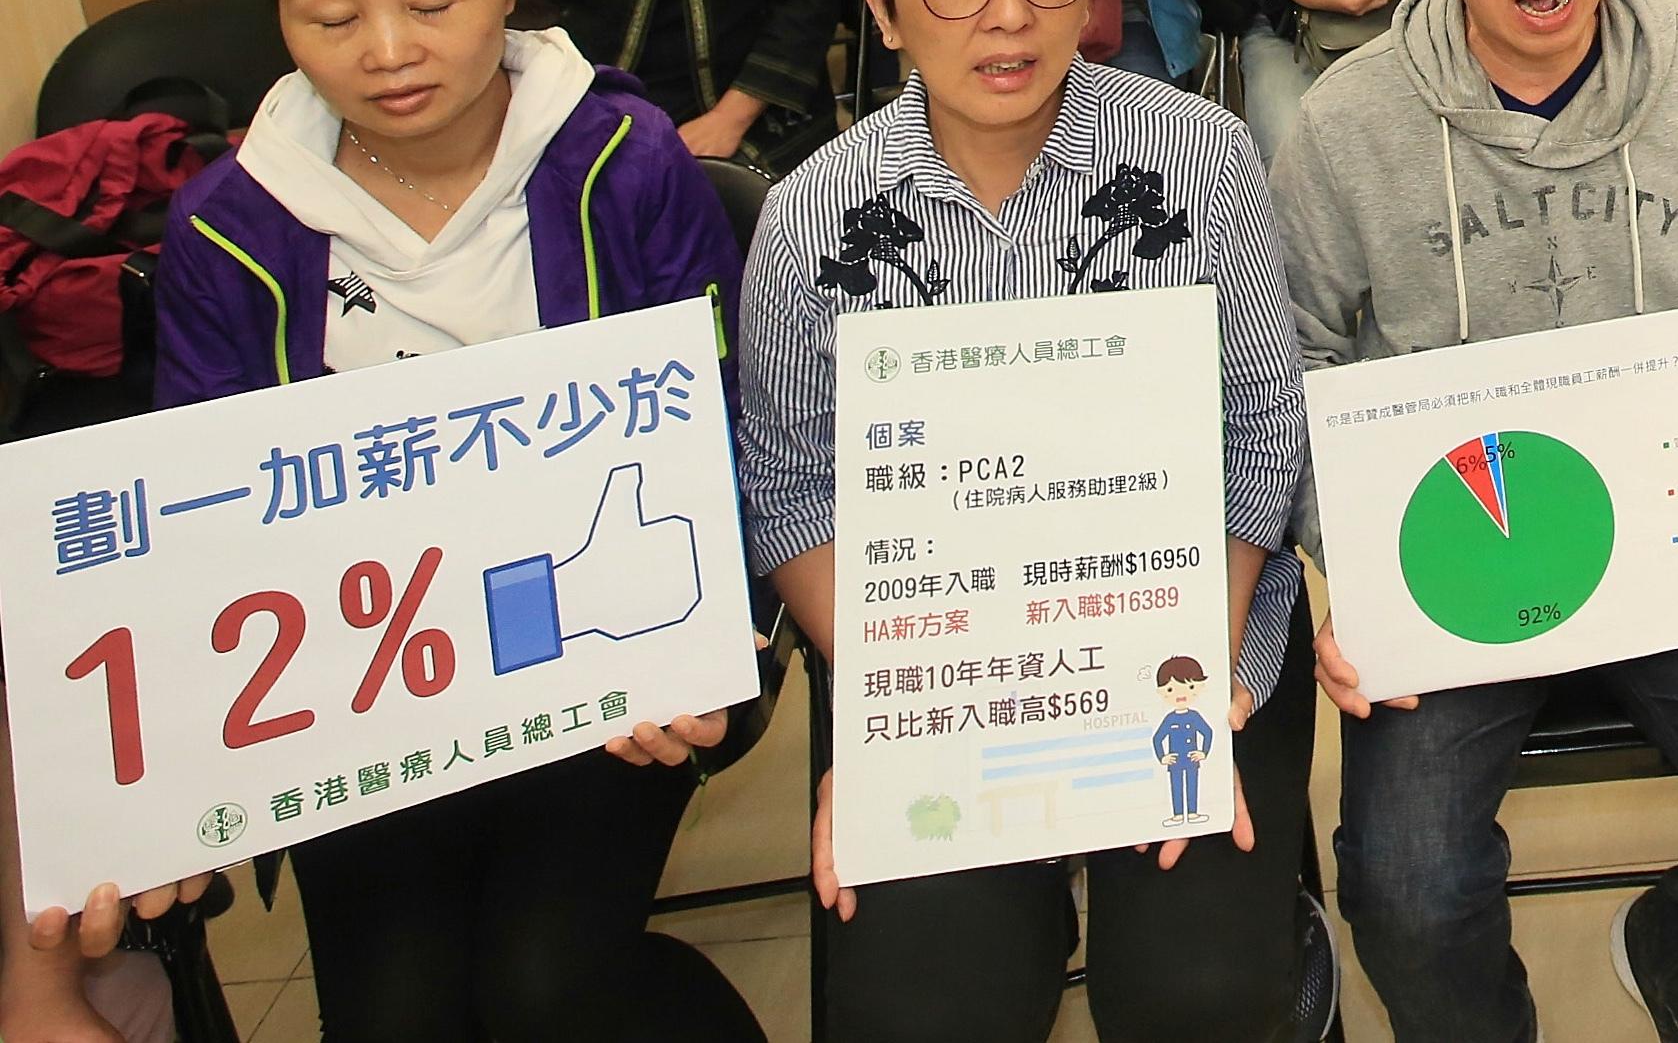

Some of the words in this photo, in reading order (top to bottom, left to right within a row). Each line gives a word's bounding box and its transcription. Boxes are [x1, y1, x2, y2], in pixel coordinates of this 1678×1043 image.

[910, 334, 1127, 374] 香港醫療人員總工會
[865, 419, 926, 451] 個案
[1485, 441, 1516, 463] 5%
[51, 359, 696, 576] 劃一加薪不少於
[1456, 452, 1488, 476] 6%
[864, 567, 996, 604] 2009年入職
[1022, 546, 1201, 587] 現時薪酬$16950
[863, 609, 970, 643] HA新方案
[1025, 586, 1180, 625] 新入職$16389
[1517, 602, 1562, 627] 92%
[65, 547, 456, 786] 12%
[863, 646, 1105, 698] 現職10年年資人工
[863, 689, 1110, 744] 只比新入職高$569
[1083, 711, 1148, 731] HOSPITAL
[269, 689, 631, 823] 香港醫療人員總工會
